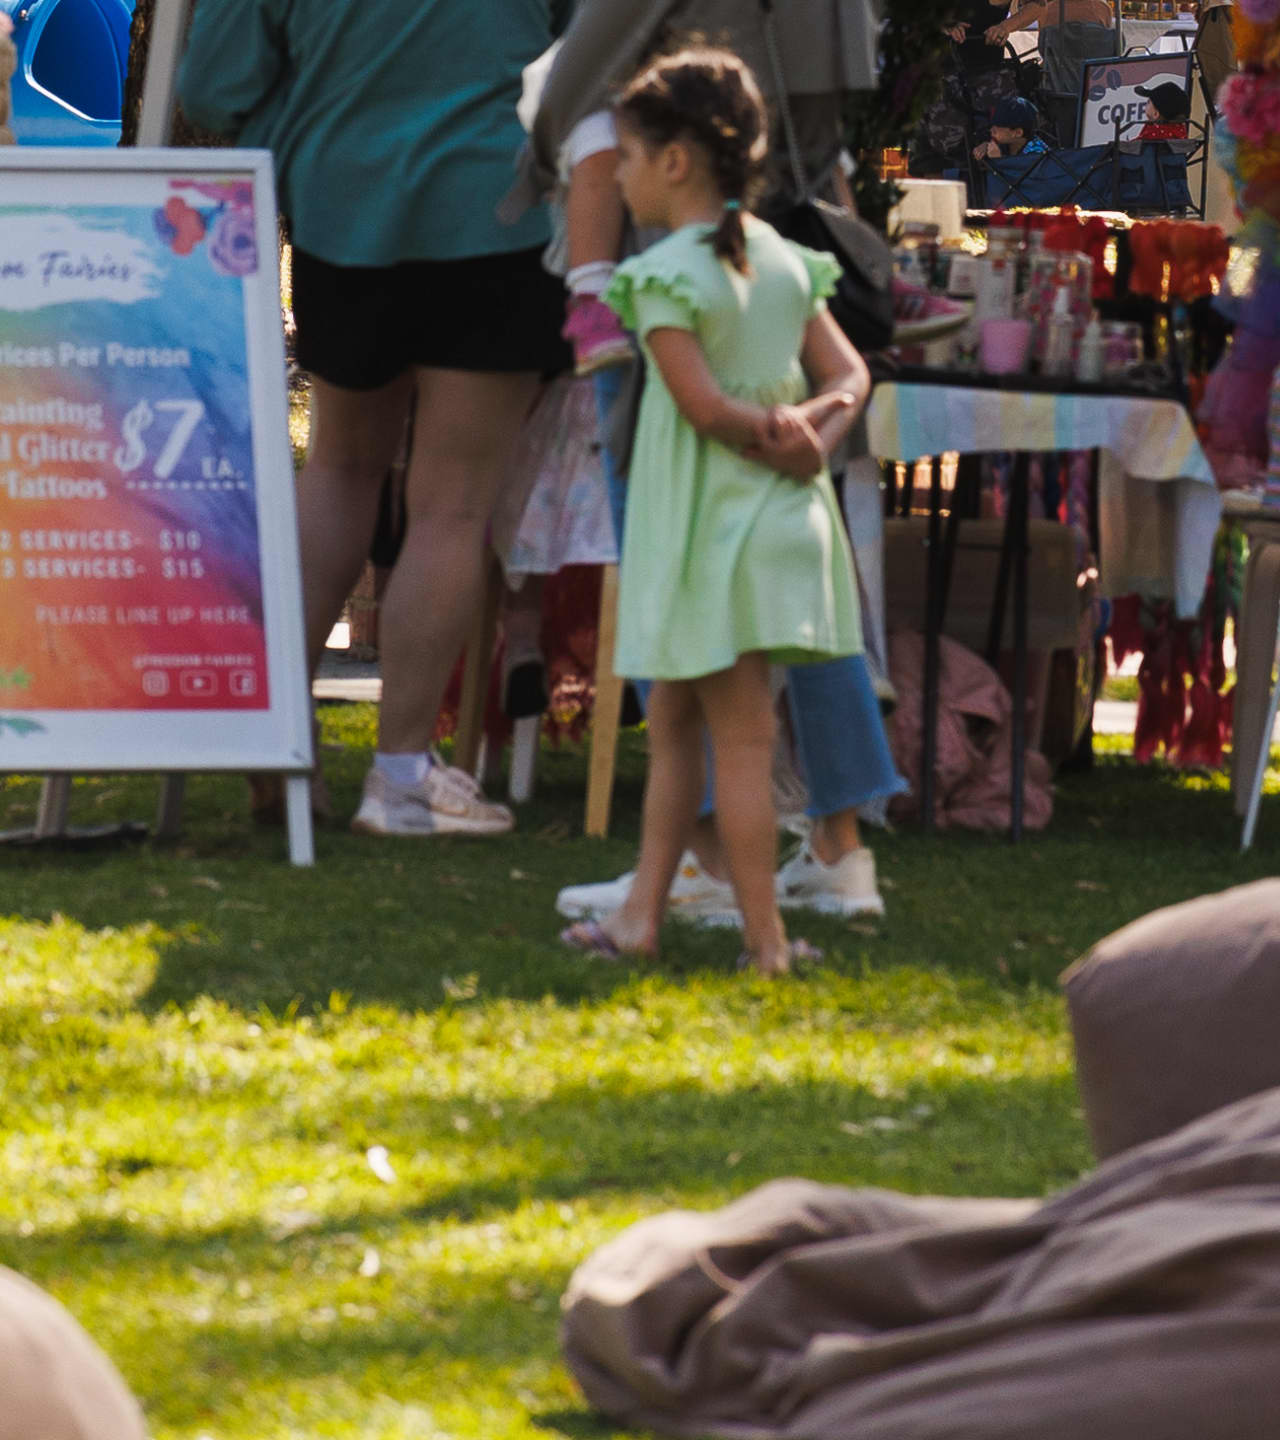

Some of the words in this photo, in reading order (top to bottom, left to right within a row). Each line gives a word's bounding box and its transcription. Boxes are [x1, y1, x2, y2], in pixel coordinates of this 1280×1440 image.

[1098, 101, 1148, 125] COFF
[0, 342, 55, 367] ices
[57, 341, 101, 368] Per
[105, 341, 191, 368] Person
[0, 397, 104, 431] ainting
[17, 432, 112, 468] Glitter
[113, 397, 205, 479] $7
[159, 529, 201, 552] $10
[161, 557, 204, 580] $15
[35, 604, 109, 625] PLEASE
[115, 606, 159, 626] LINE
[166, 606, 194, 625] UP
[200, 605, 249, 625] HERE
